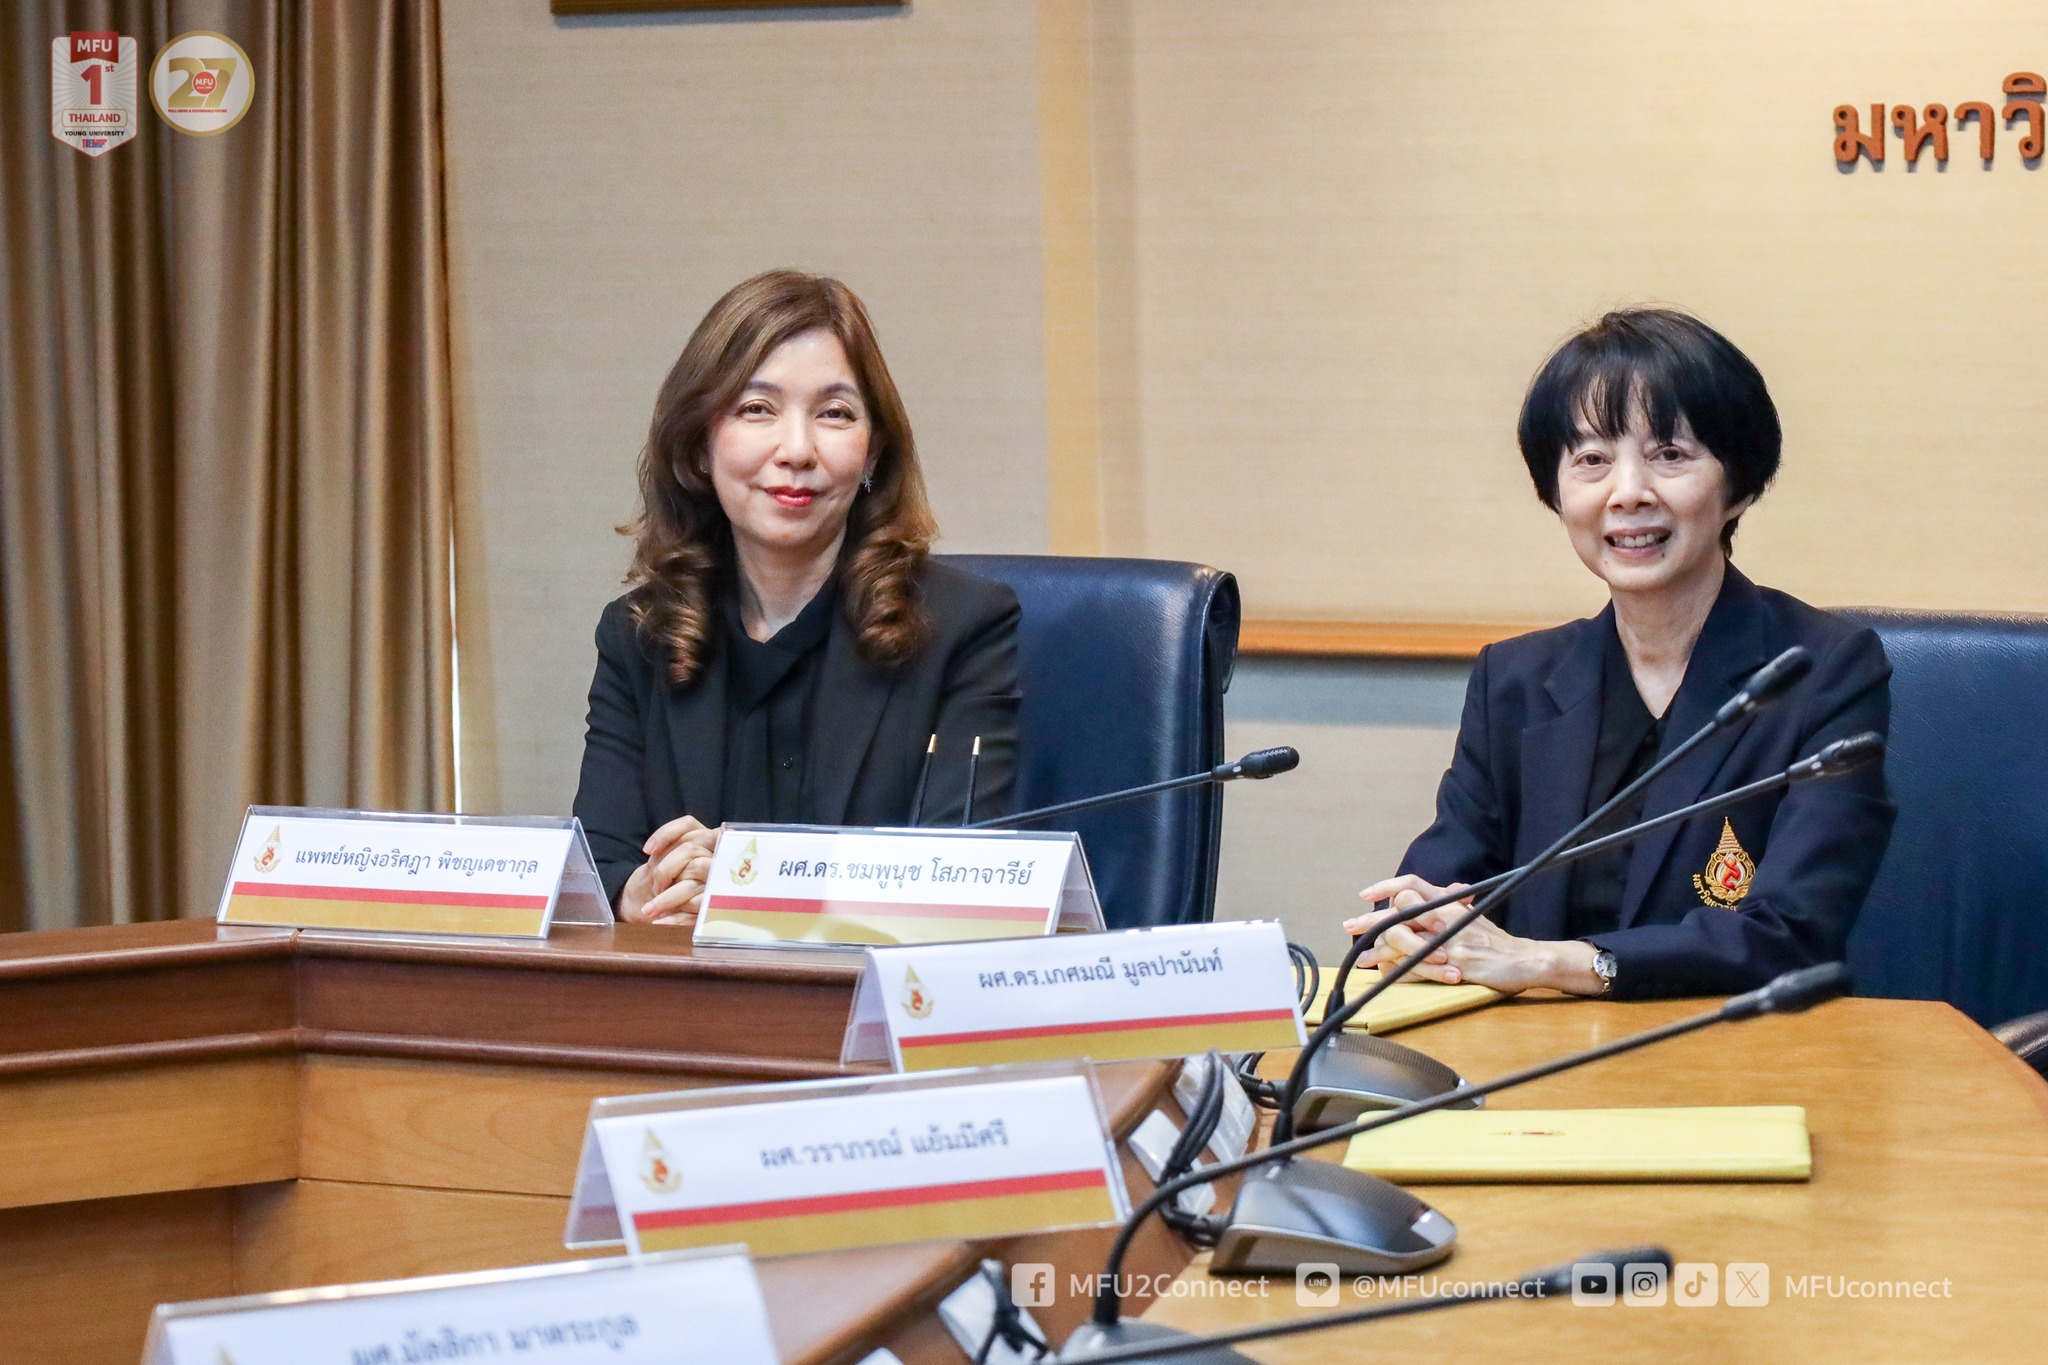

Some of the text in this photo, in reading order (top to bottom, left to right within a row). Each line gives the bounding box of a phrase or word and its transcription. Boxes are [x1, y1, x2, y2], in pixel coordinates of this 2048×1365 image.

[1833, 72, 2047, 163] มหาวิ
[438, 850, 539, 880] พิชญเดชากุล
[778, 857, 1036, 889] ผศ.ดร.ชมพูนุช โสภาจารีย์
[978, 947, 1224, 988] ผศ.ดร.เกศมณี มูลปานันท์
